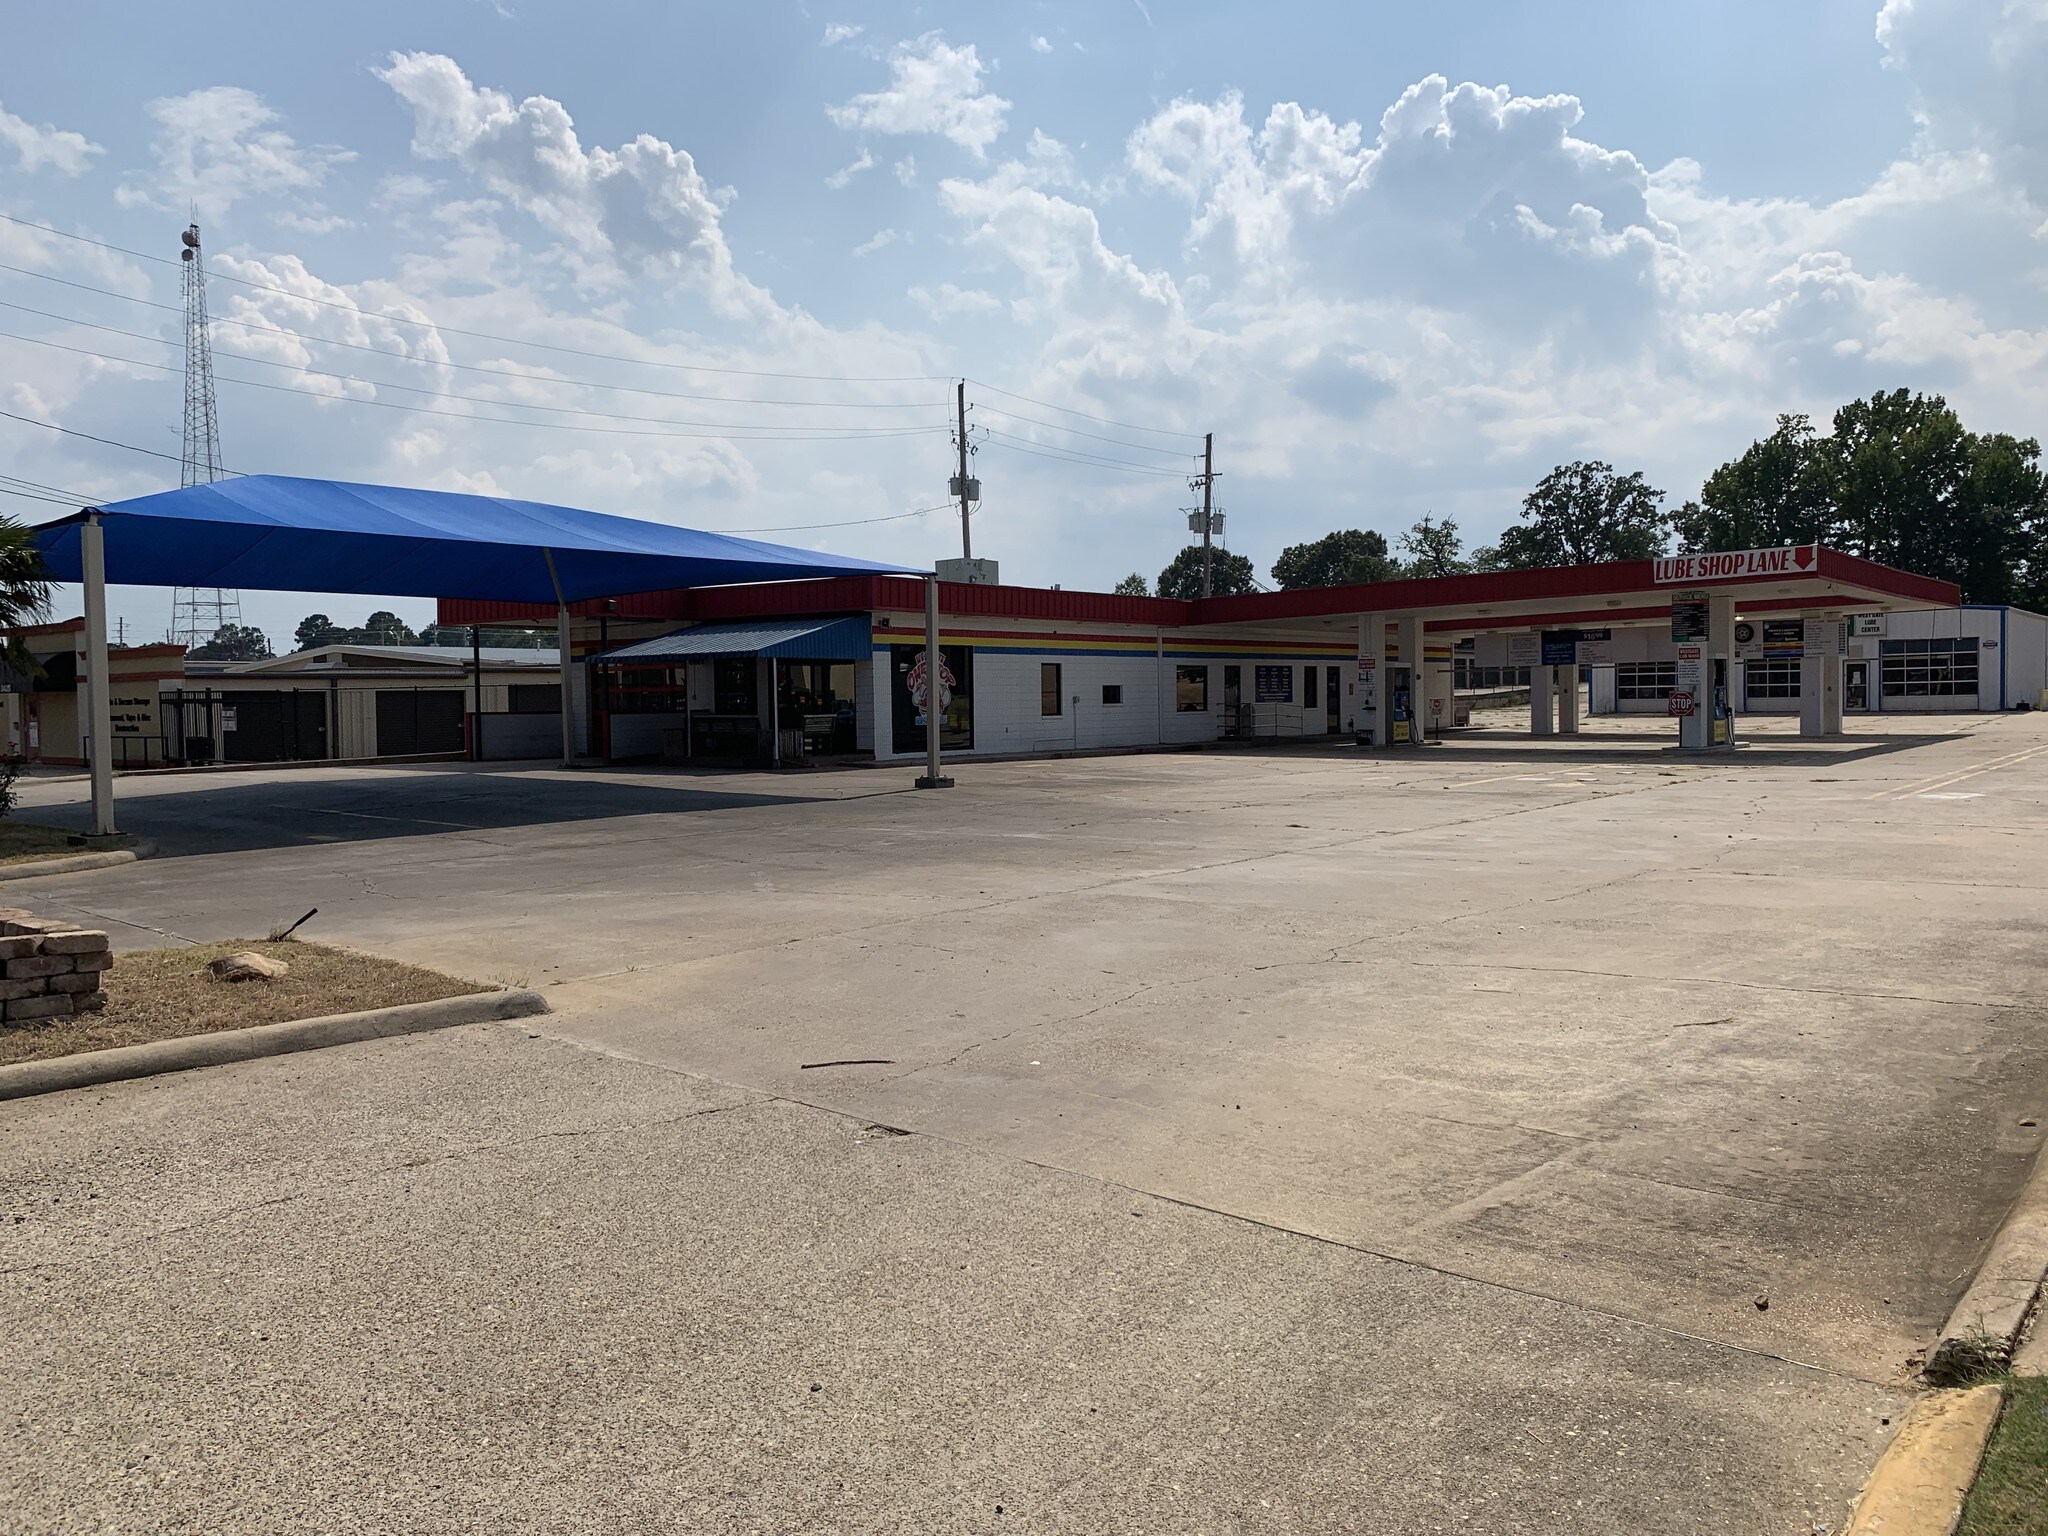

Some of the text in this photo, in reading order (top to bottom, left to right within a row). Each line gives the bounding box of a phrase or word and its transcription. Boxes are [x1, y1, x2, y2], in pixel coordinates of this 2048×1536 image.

[1656, 550, 1791, 580] LUBE SHOP LANE
[1671, 698, 1692, 709] STOP
